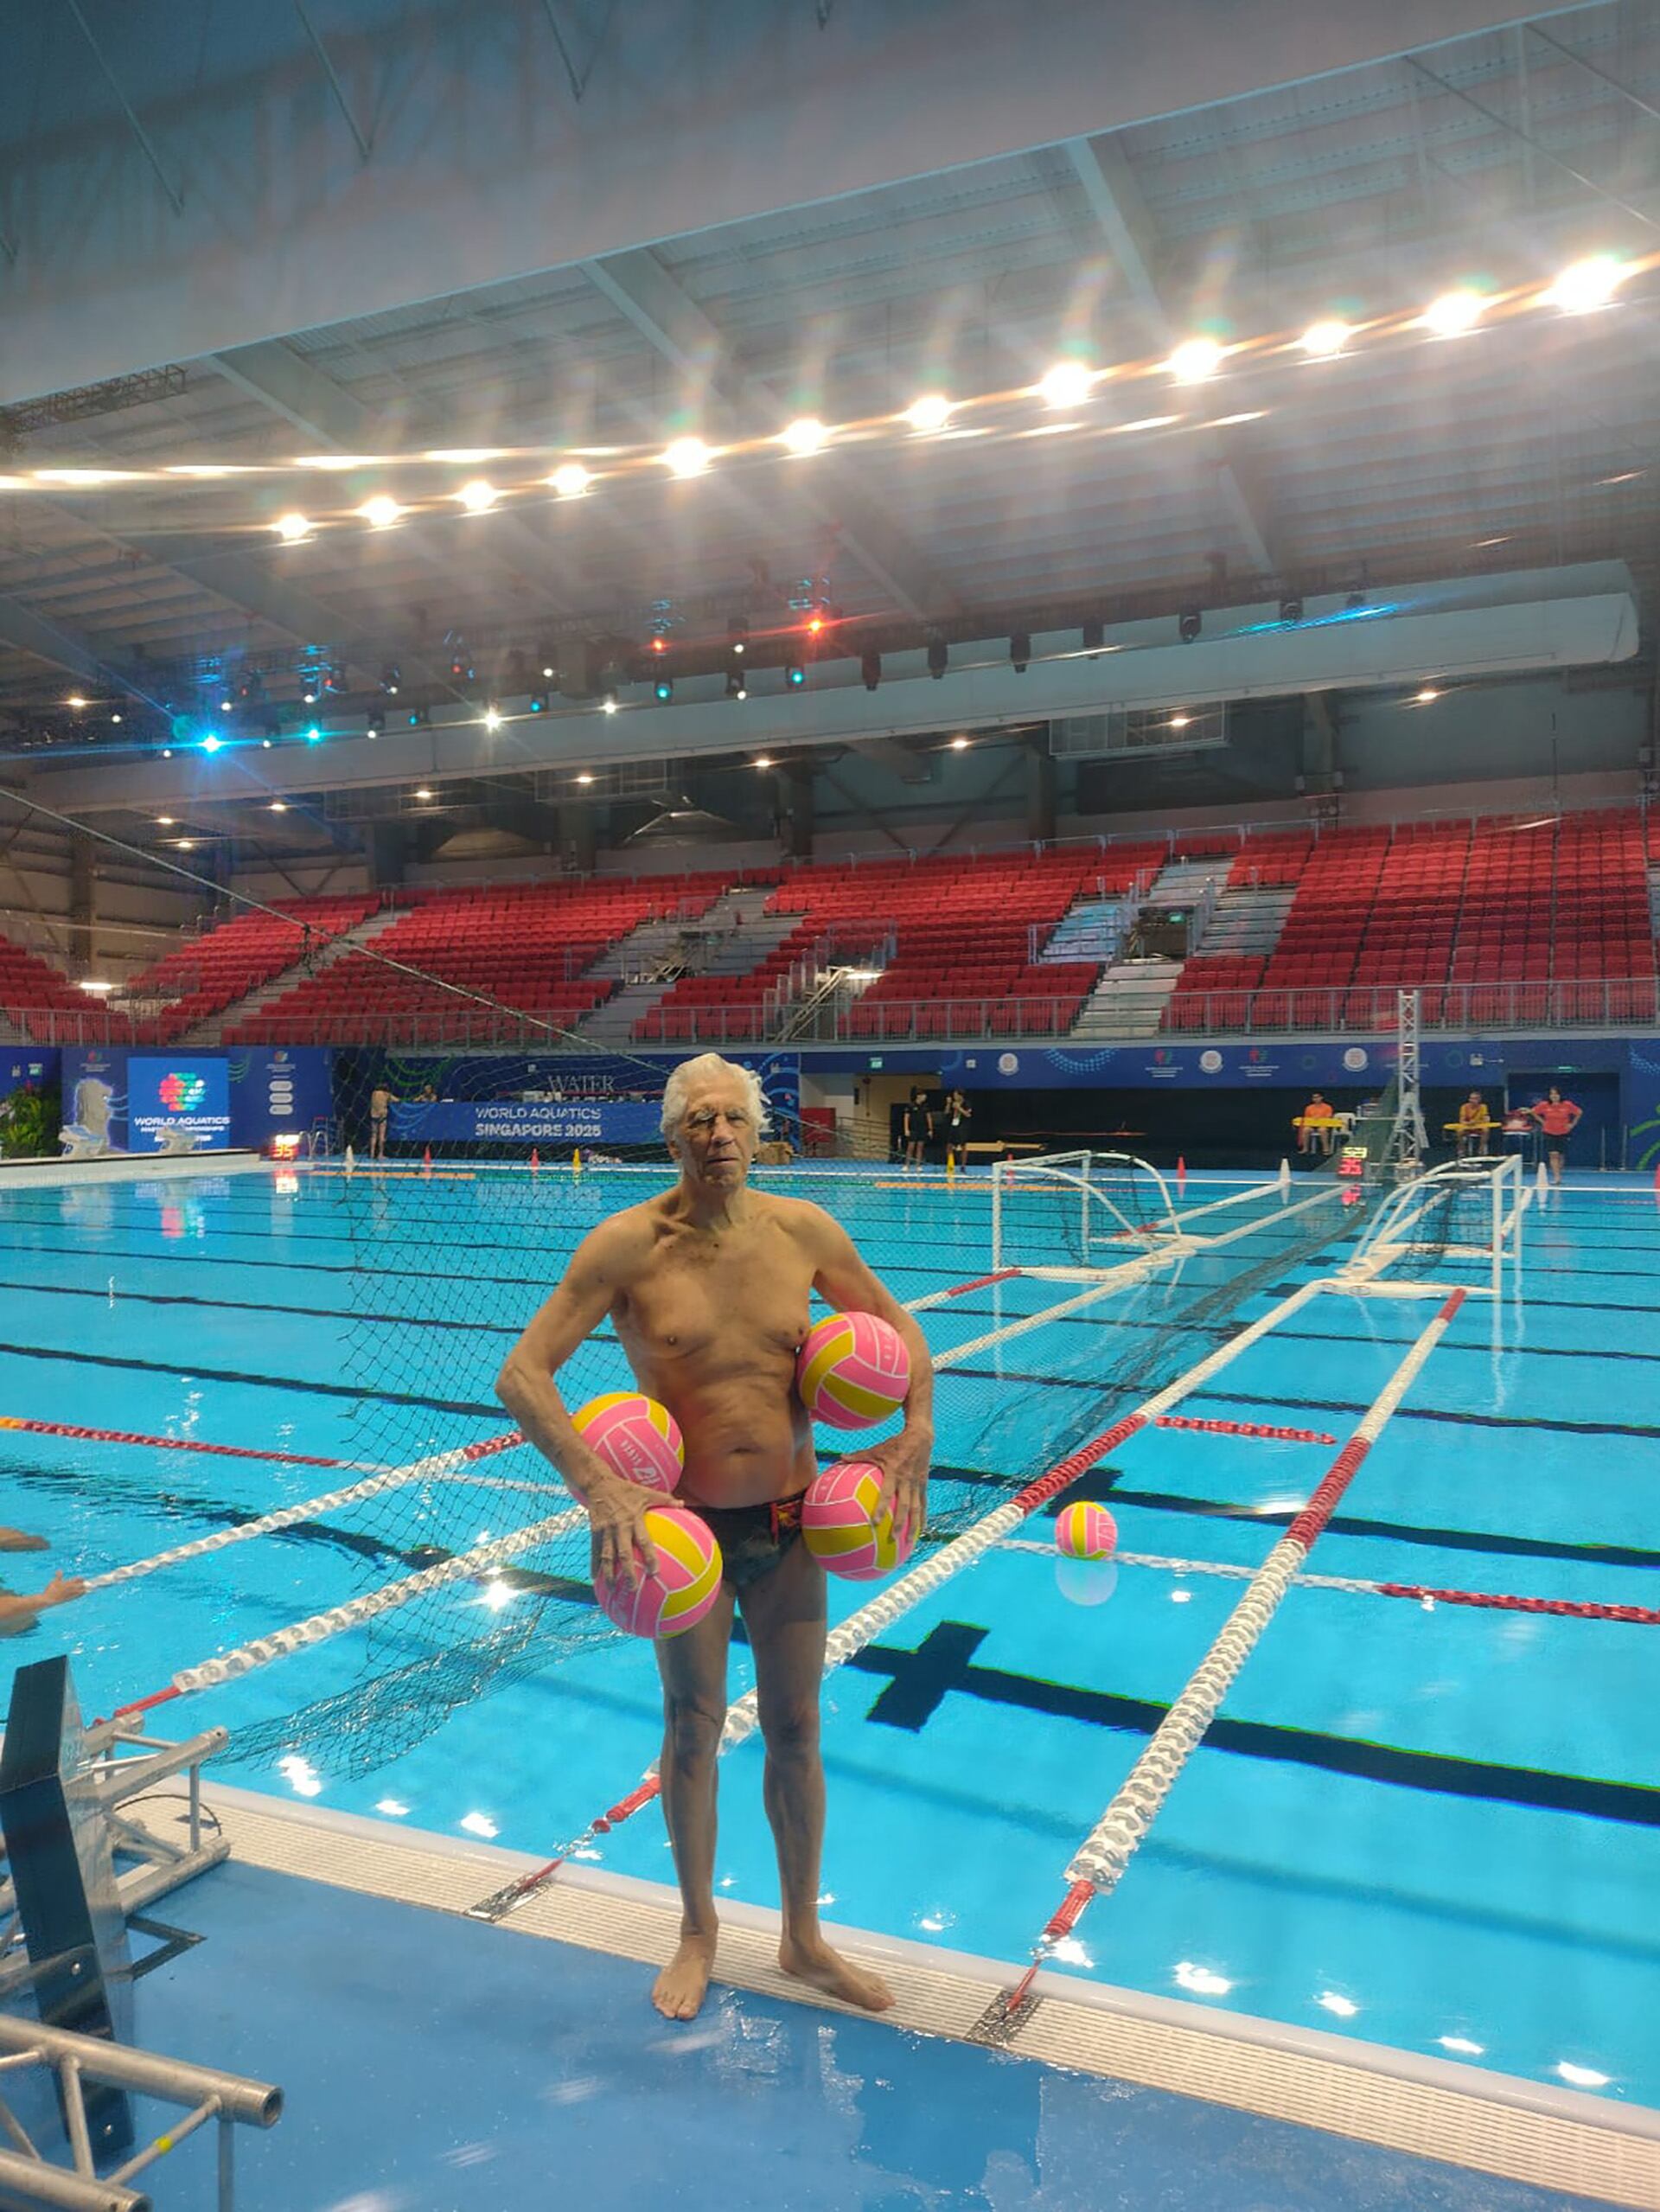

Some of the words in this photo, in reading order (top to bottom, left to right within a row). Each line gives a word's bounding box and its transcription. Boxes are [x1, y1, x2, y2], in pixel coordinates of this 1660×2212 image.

[548, 1075, 615, 1092] WATER
[476, 1108, 527, 1119] WORLD
[529, 1107, 602, 1119] AQUATICS
[134, 1117, 175, 1126] WORLD
[475, 1124, 562, 1136] SINGAPORE
[565, 1124, 602, 1137] 2025
